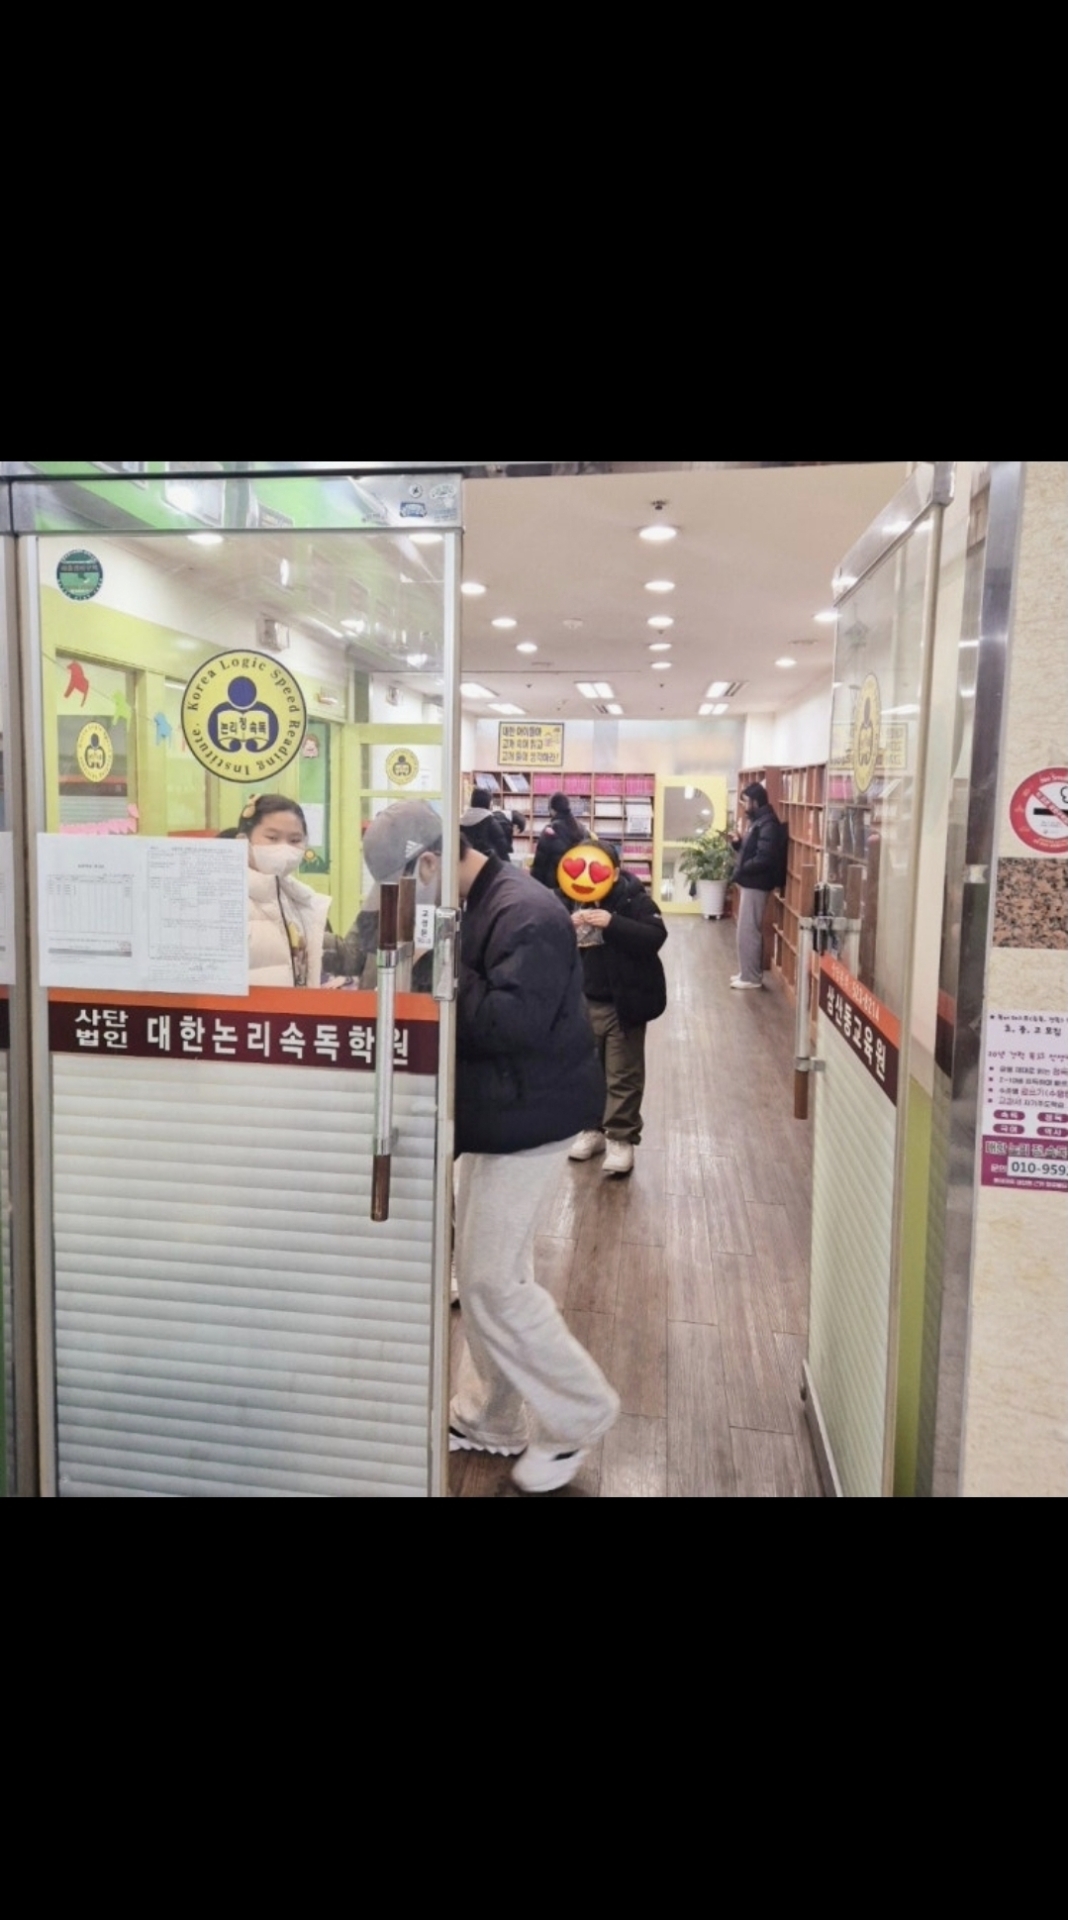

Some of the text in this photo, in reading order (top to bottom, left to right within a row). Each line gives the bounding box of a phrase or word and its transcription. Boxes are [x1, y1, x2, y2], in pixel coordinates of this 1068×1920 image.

[218, 657, 267, 671] Logic
[187, 668, 217, 711] Korea
[270, 668, 300, 712] Speed
[256, 719, 301, 771] Reading
[75, 1008, 129, 1028] 사단
[76, 1028, 128, 1049] 법인
[826, 984, 887, 1082] 삼산동교육원
[147, 1015, 409, 1065] 대한논리속독학원
[1011, 1161, 1068, 1176] 010-959
